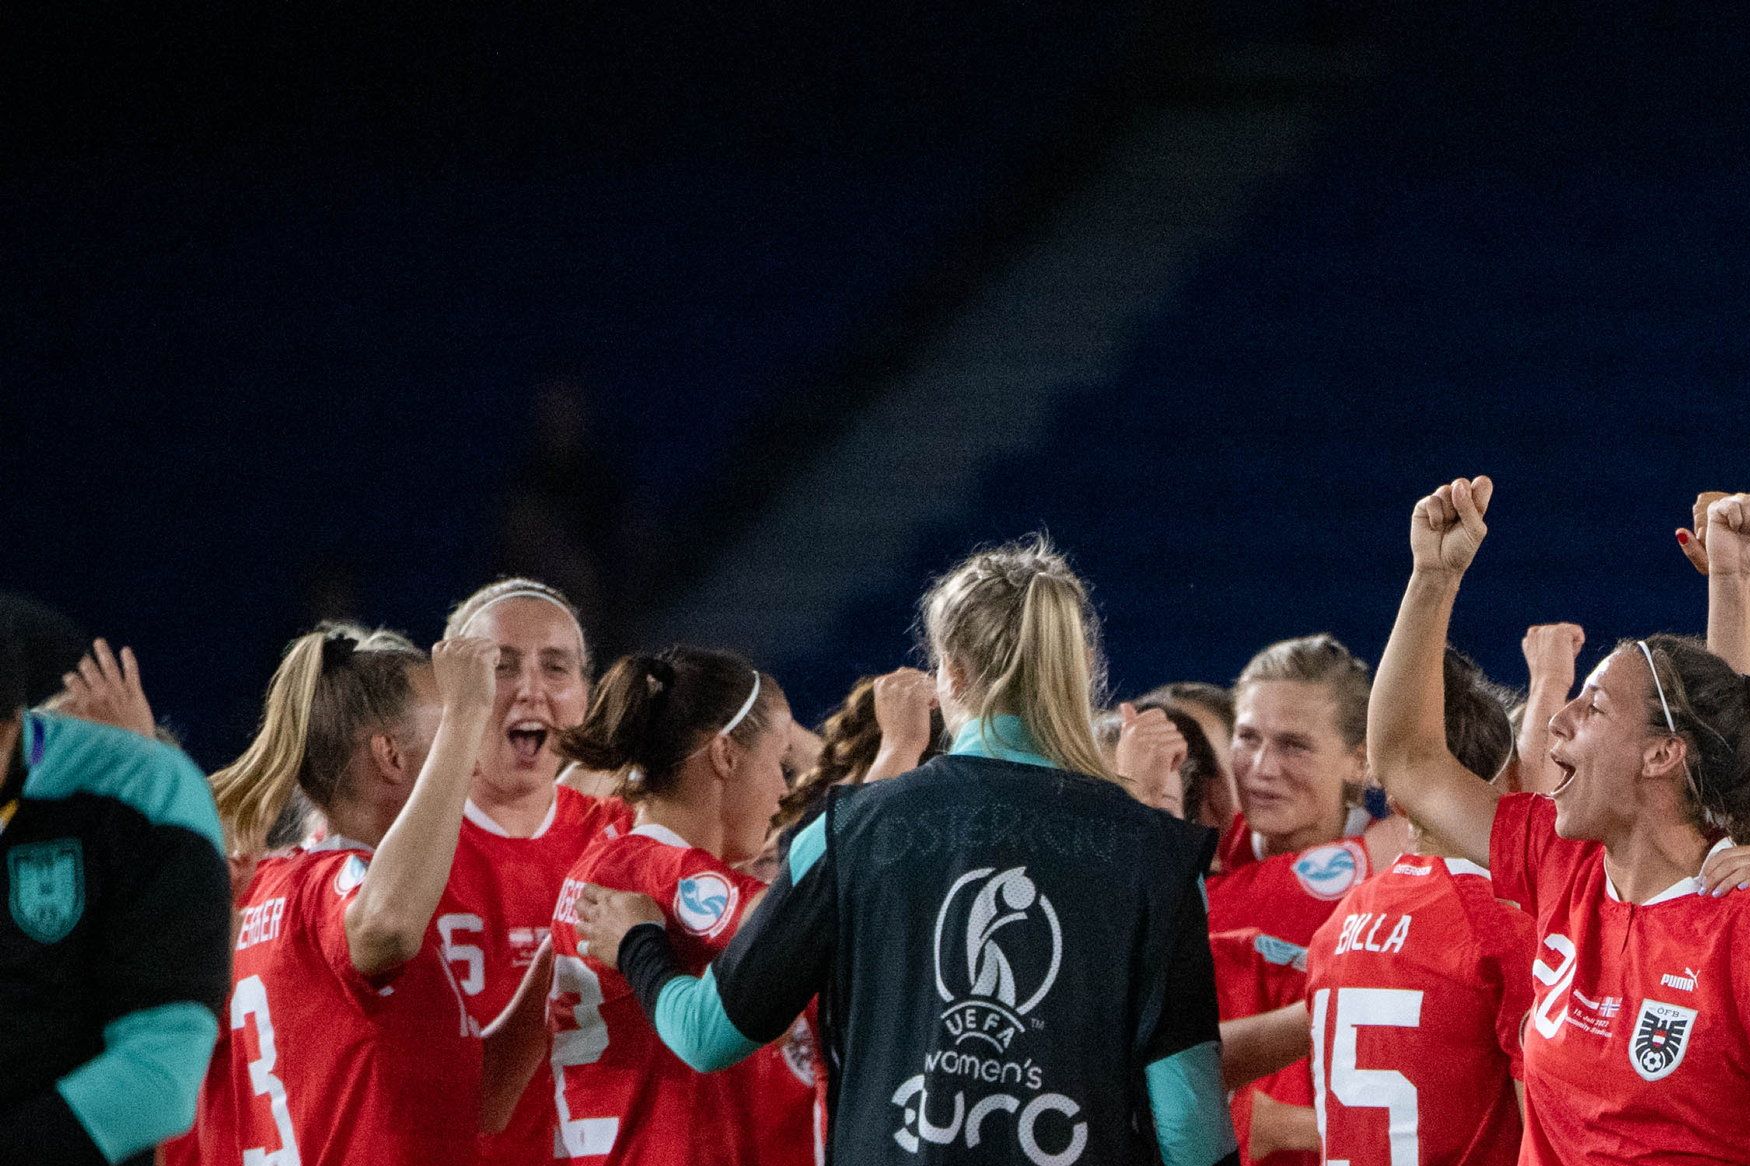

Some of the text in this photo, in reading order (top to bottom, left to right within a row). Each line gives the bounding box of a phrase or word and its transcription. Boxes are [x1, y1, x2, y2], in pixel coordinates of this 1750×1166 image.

[1334, 912, 1412, 956] BILLA
[1660, 973, 1695, 992] PUMA
[946, 1008, 1015, 1049] UEFA
